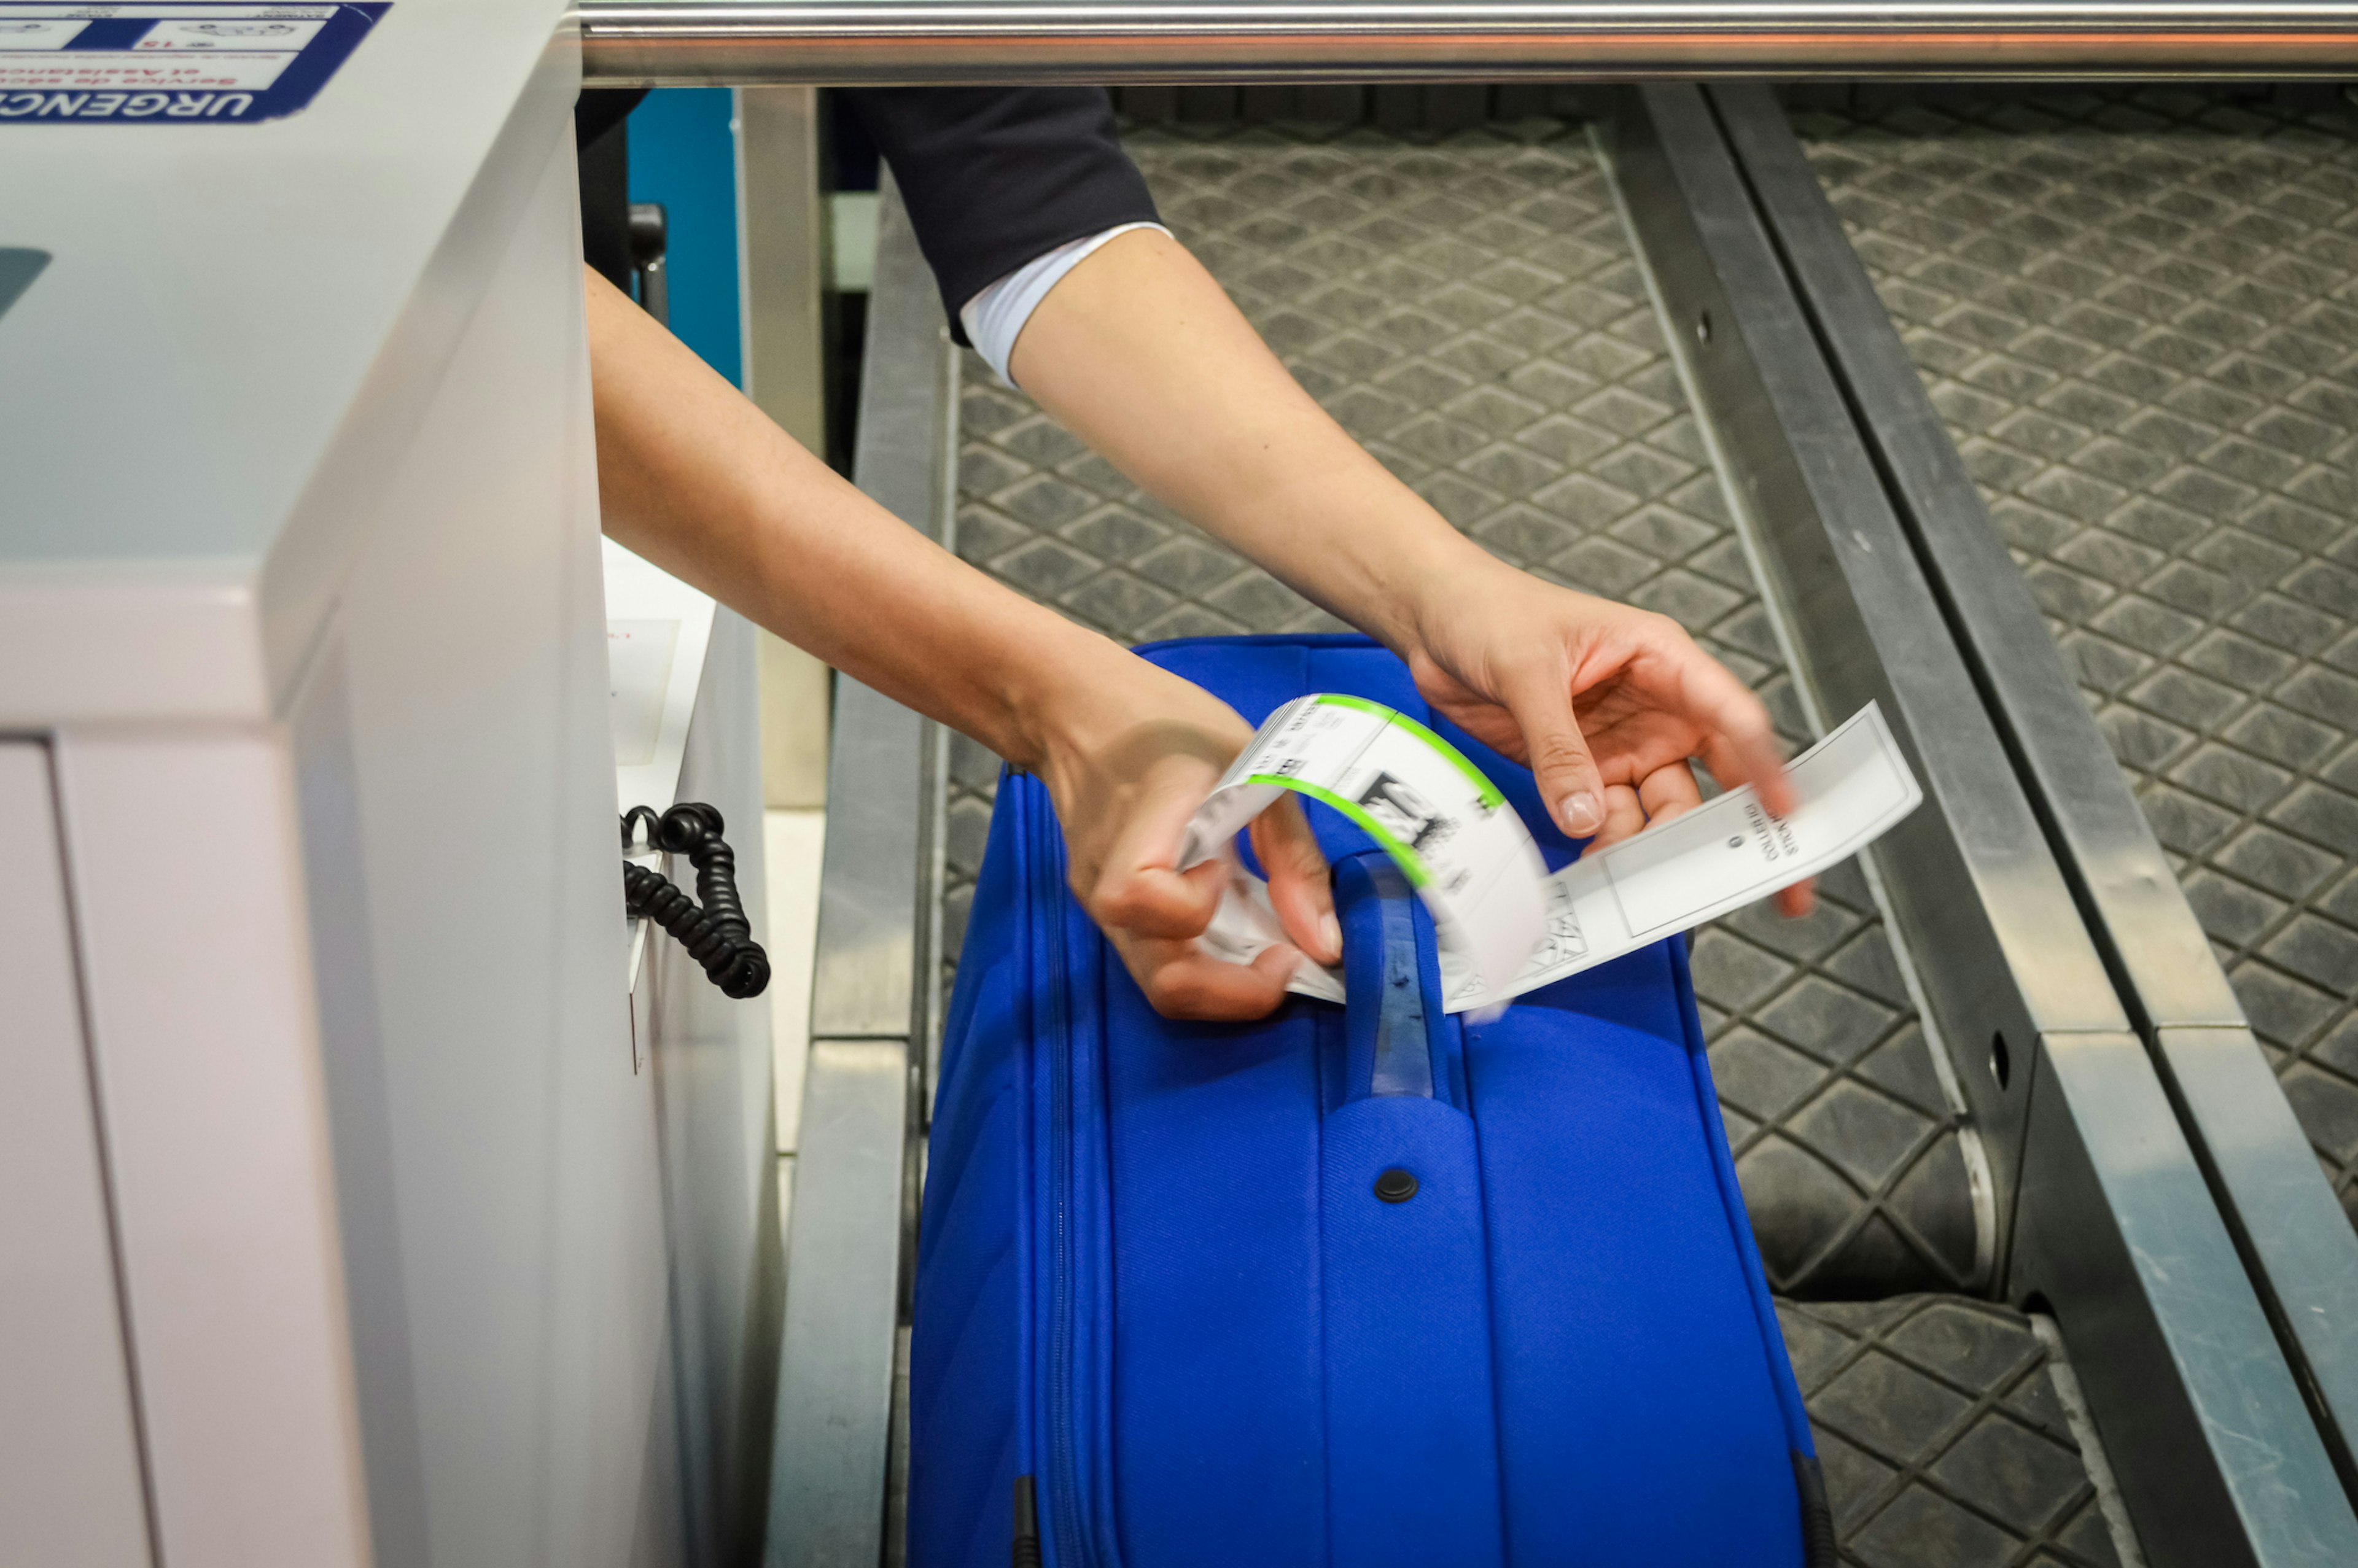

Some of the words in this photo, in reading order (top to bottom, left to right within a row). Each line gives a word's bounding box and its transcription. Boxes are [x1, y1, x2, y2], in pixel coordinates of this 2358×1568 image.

[0, 93, 254, 117] URGENC
[1745, 803, 1759, 818] ICI
[1753, 818, 1780, 861] COLLER
[1776, 821, 1799, 856] STICK
